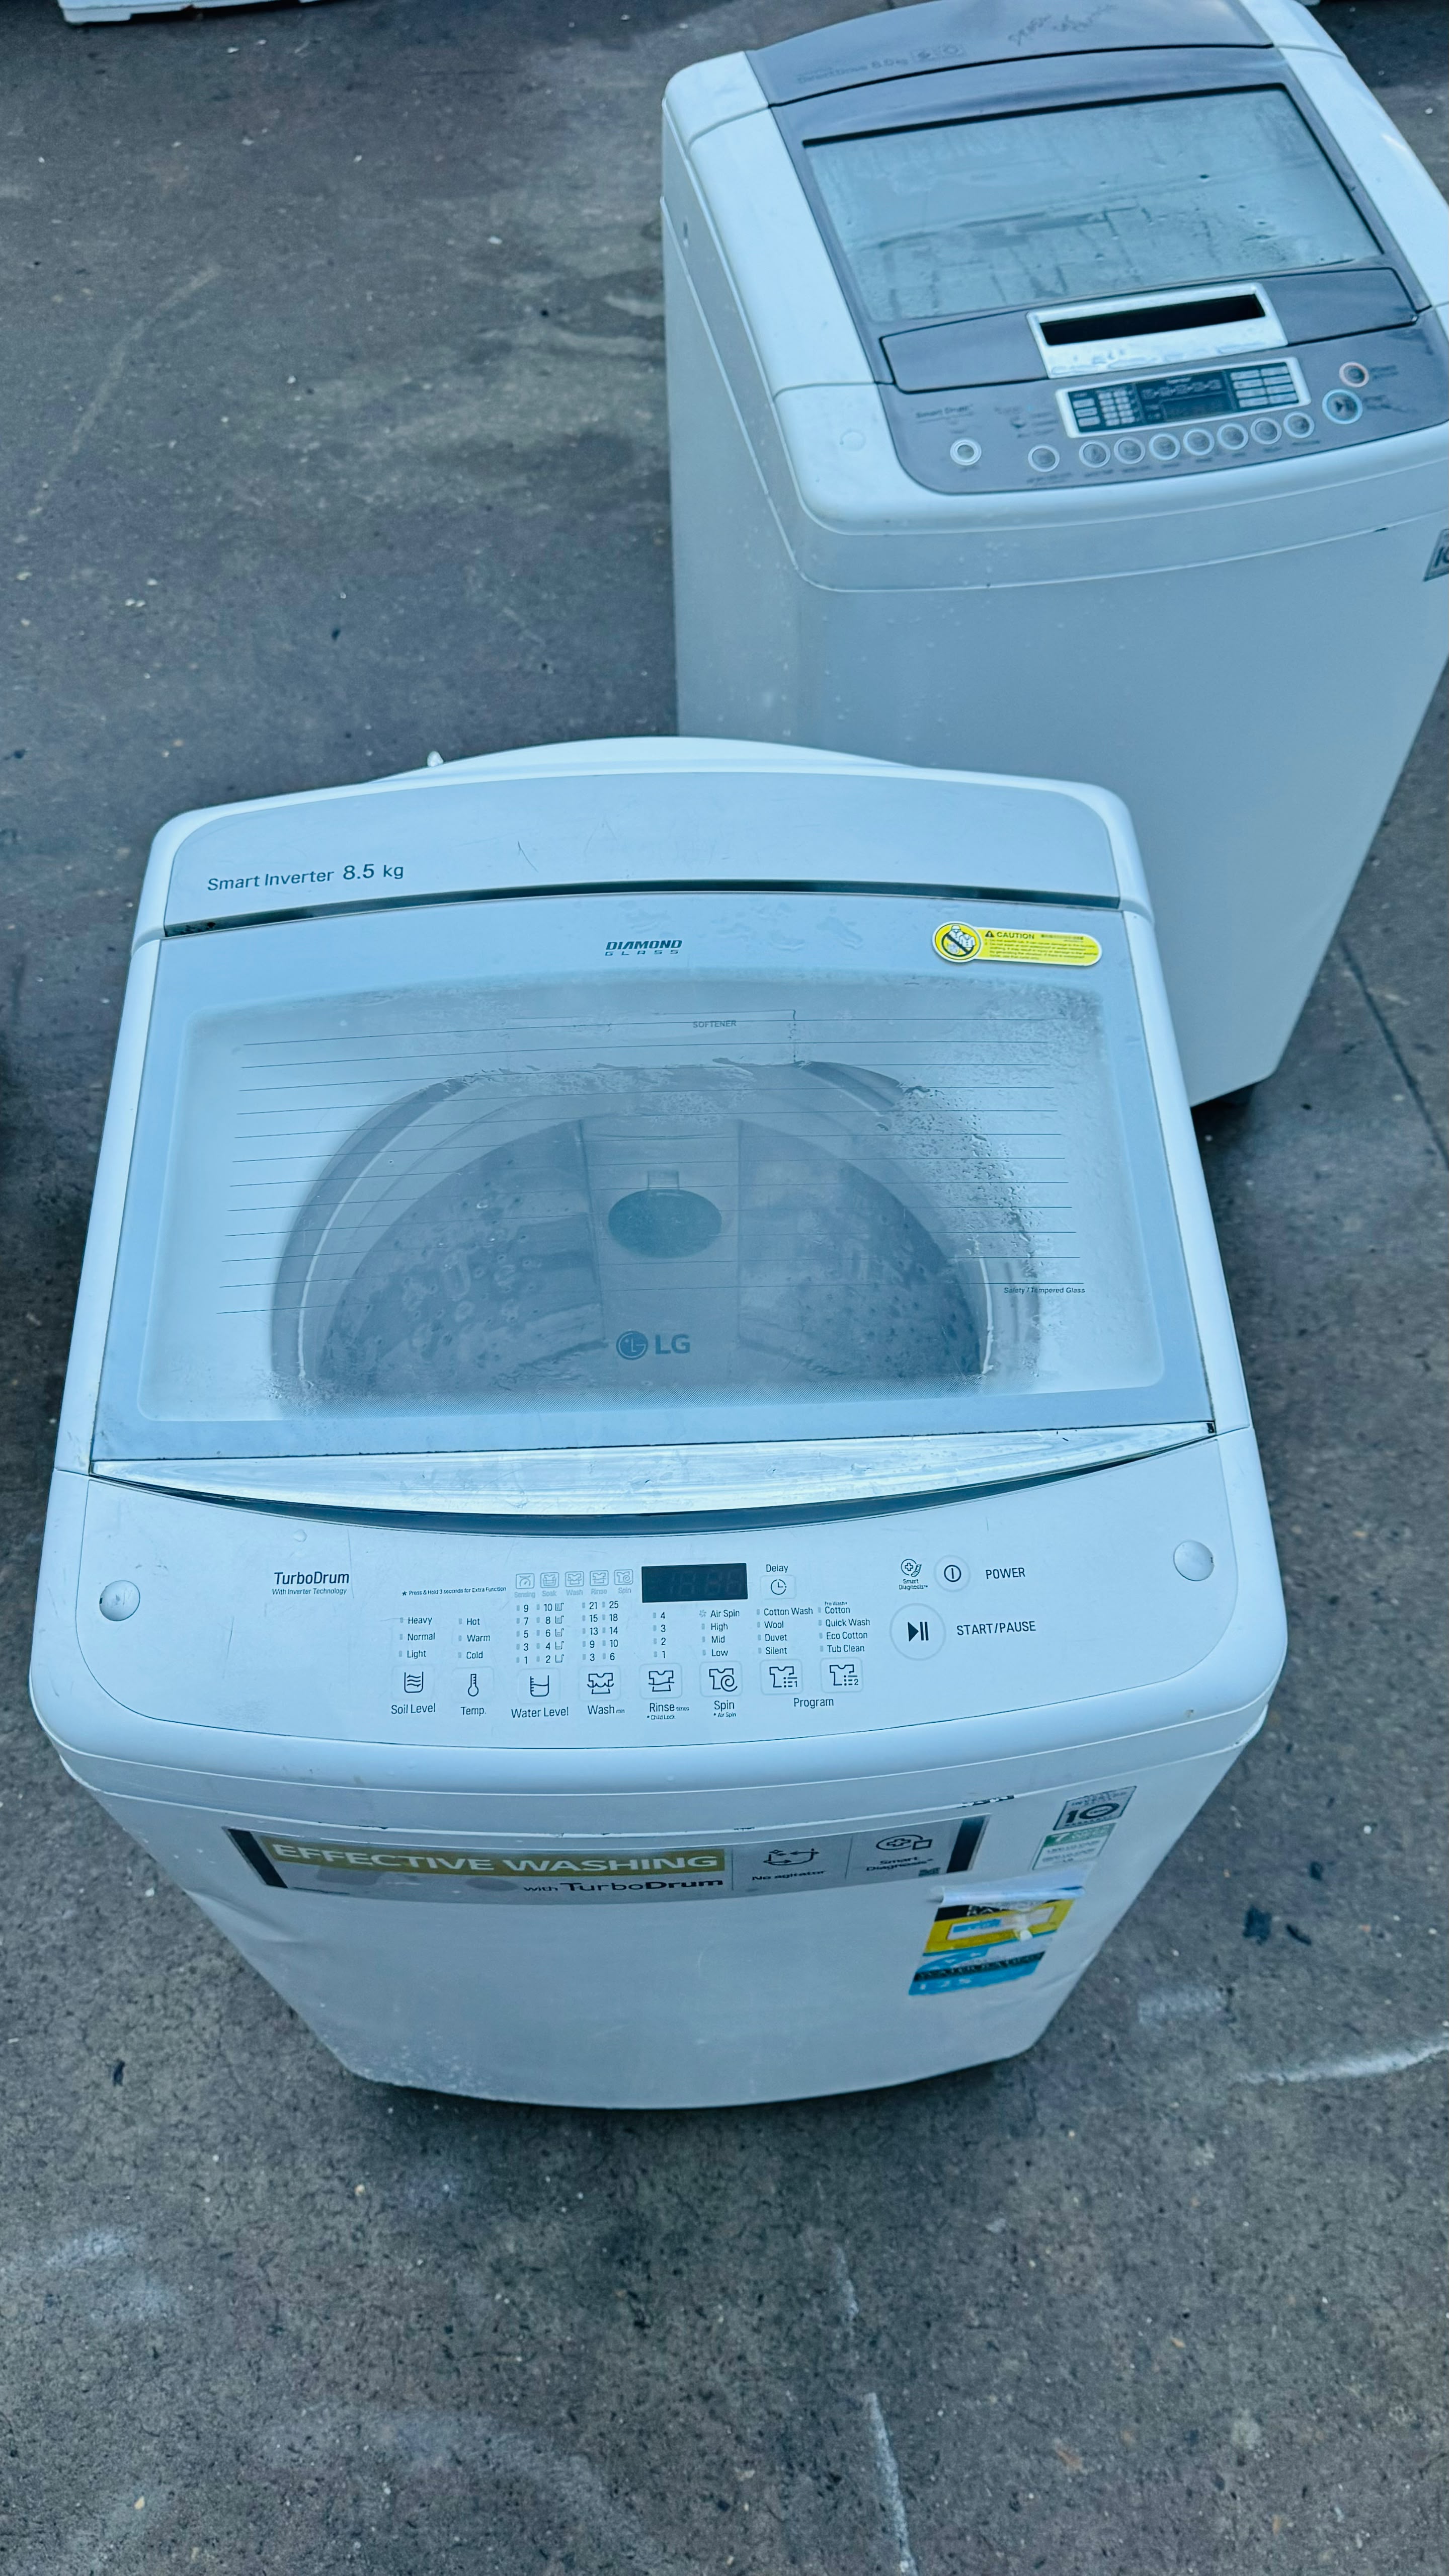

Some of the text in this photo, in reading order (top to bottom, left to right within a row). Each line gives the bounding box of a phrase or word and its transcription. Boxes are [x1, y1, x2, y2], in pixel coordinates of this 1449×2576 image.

[207, 864, 404, 891] Smart Inverter 8.5 kg
[606, 940, 683, 950] DIAMOND
[693, 1020, 737, 1028] SOFTENER
[656, 1334, 690, 1354] LG
[766, 1564, 788, 1573] Delay
[986, 1567, 1025, 1579] POWER
[274, 1571, 349, 1584] TurboDrum
[544, 1603, 552, 1612] 10
[764, 1607, 813, 1616] Cotton Wash
[825, 1606, 850, 1614] Cotton
[609, 1614, 618, 1622] 18
[723, 1609, 740, 1618] Spin
[408, 1617, 432, 1625] Heavy
[524, 1617, 529, 1625] 7
[590, 1615, 598, 1623] 15
[825, 1618, 870, 1627] Quick Wash
[661, 1624, 666, 1632] 3
[711, 1623, 728, 1632] High
[764, 1621, 784, 1629] Wool
[957, 1621, 1036, 1636] START/PAUSE
[524, 1630, 529, 1638] 5
[545, 1629, 551, 1637] 6
[610, 1627, 618, 1635] 14
[408, 1633, 435, 1641] Normal
[661, 1637, 666, 1646] 2
[711, 1635, 725, 1643] Mid
[524, 1643, 529, 1651] 3
[545, 1642, 550, 1650] 4
[590, 1640, 595, 1648] 9
[610, 1639, 618, 1648] 10
[827, 1644, 865, 1653] Tub Clean
[407, 1650, 426, 1659] Light
[466, 1651, 483, 1659] Cold
[590, 1653, 595, 1661] 3
[610, 1653, 615, 1661] 6
[662, 1650, 666, 1658] 1
[545, 1655, 551, 1663] 2
[650, 1703, 675, 1712] Rinse
[714, 1700, 735, 1712] Spin
[794, 1698, 834, 1709] Program
[391, 1703, 436, 1714] Soil Level
[460, 1706, 487, 1716] Temp.
[511, 1707, 569, 1718] Water Level
[587, 1705, 614, 1715] Wash
[274, 1844, 717, 1871] EFFECTIVE WASHING
[774, 1870, 826, 1879] agitator
[560, 1879, 723, 1891] TurboDrum
